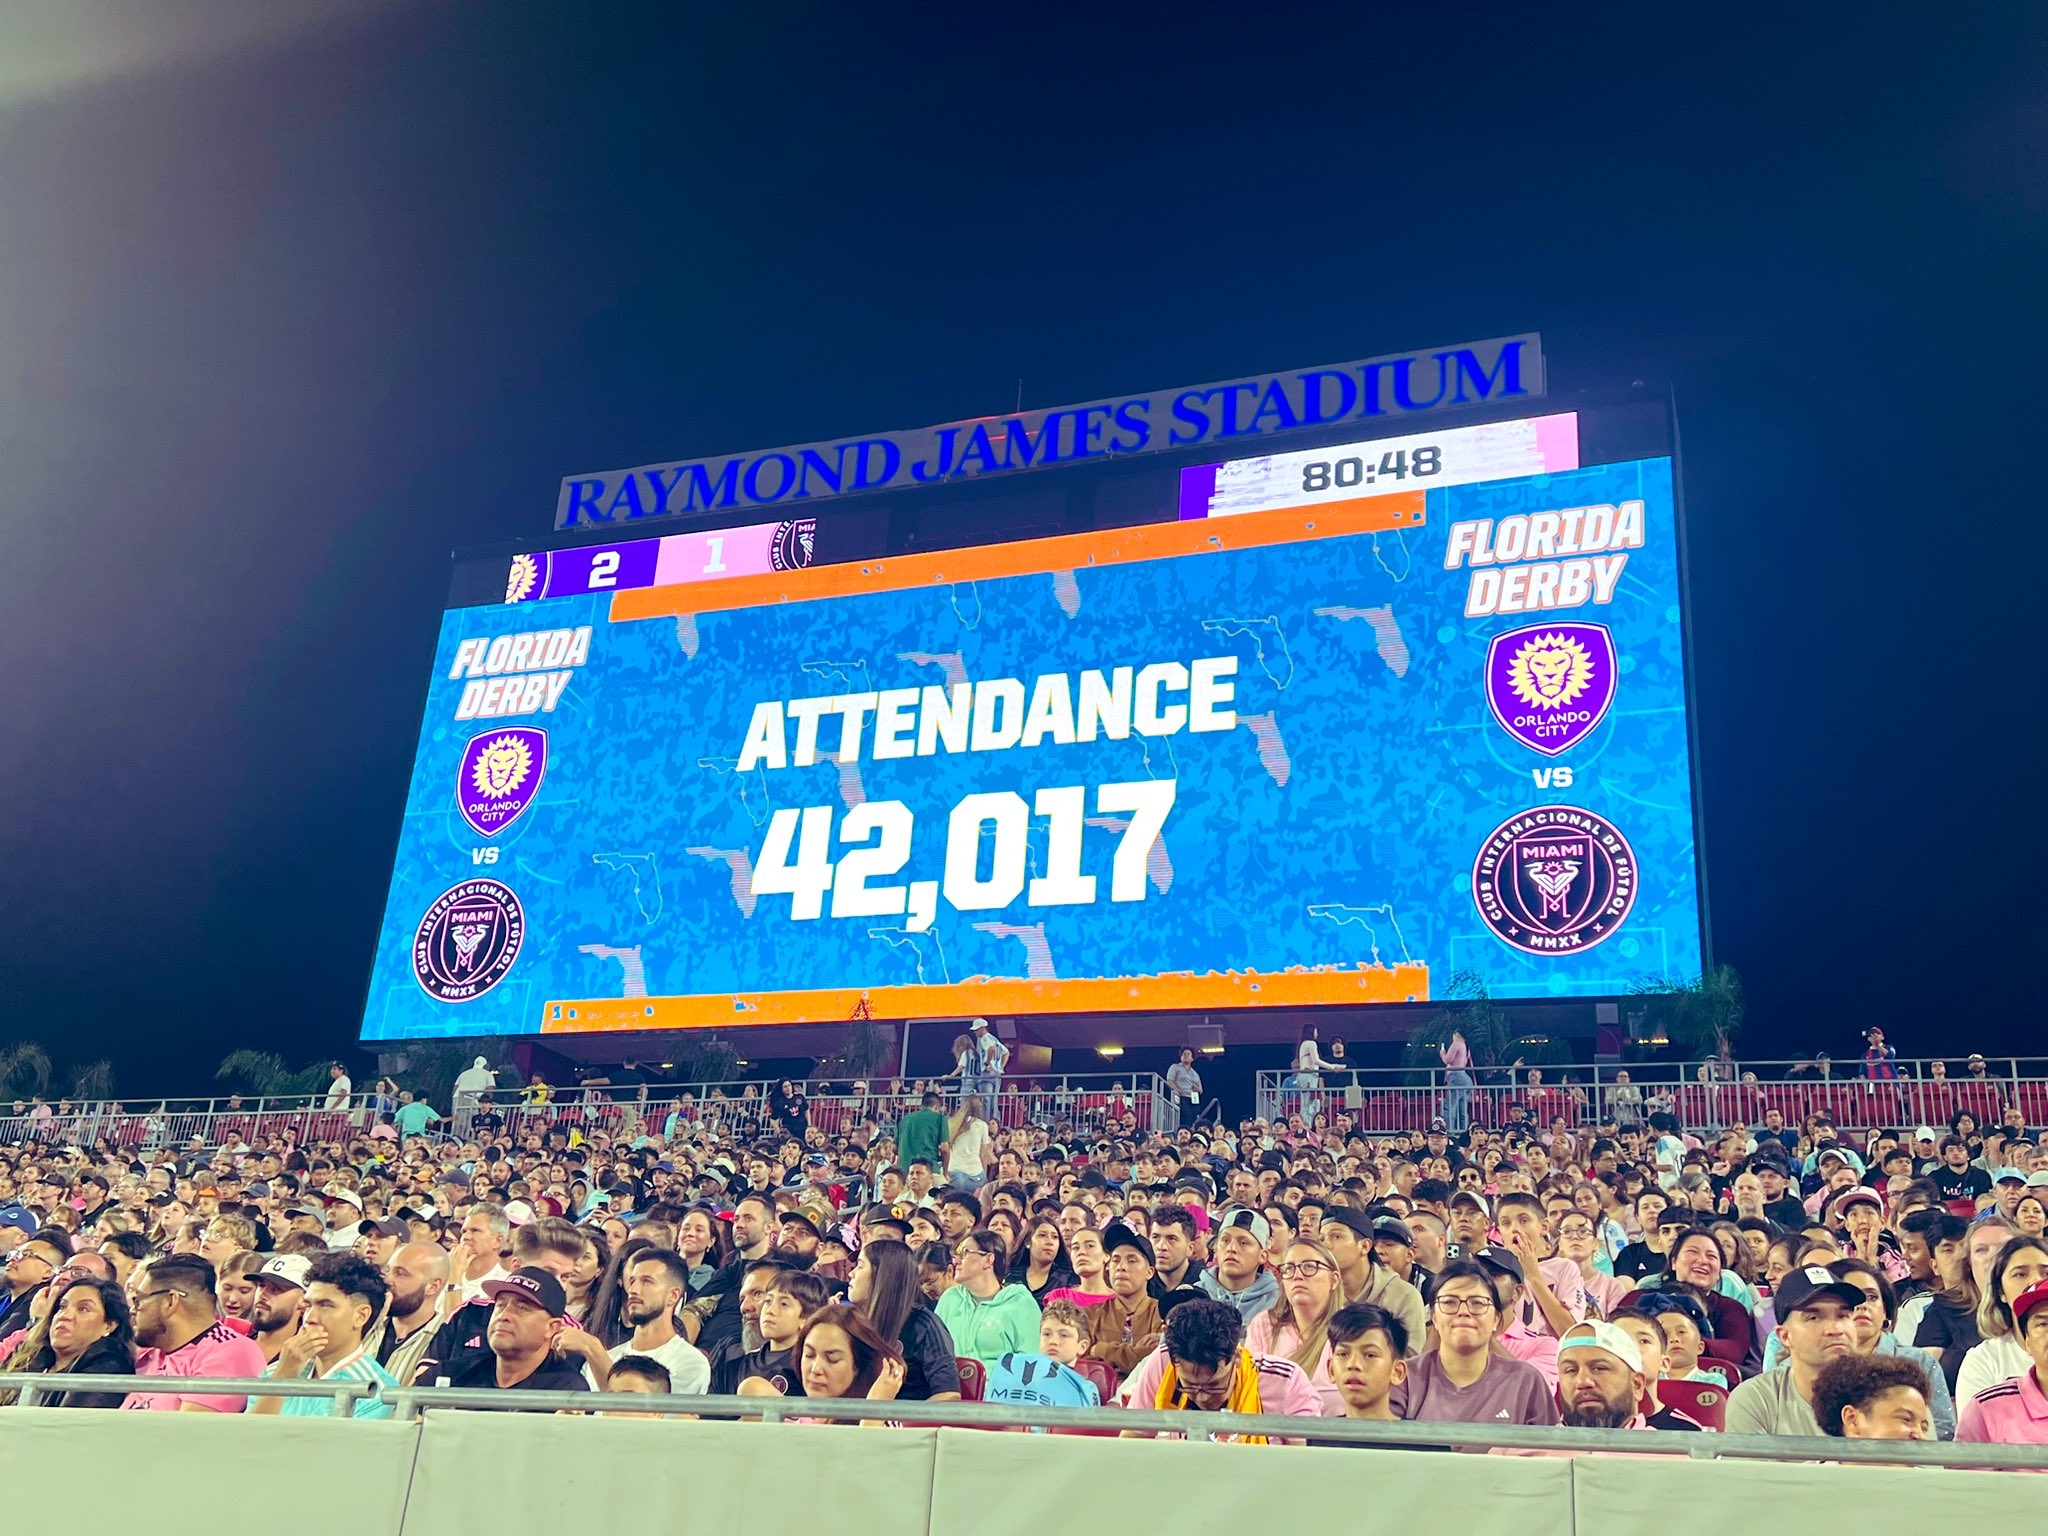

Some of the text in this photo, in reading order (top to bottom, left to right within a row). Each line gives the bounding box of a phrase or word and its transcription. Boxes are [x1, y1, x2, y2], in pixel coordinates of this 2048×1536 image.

[560, 341, 1528, 528] RAYMOND JAMES STADIUM
[1303, 445, 1442, 492] 80:48
[772, 519, 793, 569] CLUB INTE
[1444, 500, 1644, 569] FLORIDA
[587, 551, 621, 589] 2
[702, 537, 727, 573] 1
[1464, 553, 1629, 618] DERBY
[448, 626, 592, 679] FLORIDA
[454, 670, 573, 721] DERBY
[736, 656, 1239, 772] ATTENDANCE
[1514, 710, 1591, 727] ORLANDO
[1535, 723, 1570, 738] CITY
[1532, 766, 1573, 789] VS
[468, 800, 521, 814] ORLANDO
[481, 811, 506, 823] CITY
[472, 846, 500, 865] VS
[750, 778, 1177, 932] 42,017
[1481, 812, 1600, 875] INTERNACIONAL
[1523, 844, 1584, 859] MIAMI
[1602, 835, 1622, 854] DE
[421, 884, 508, 936] INTERNACIONAL
[451, 910, 494, 923] MIAMI
[506, 902, 518, 919] DE
[1480, 881, 1503, 921] CLUB
[417, 941, 429, 974] CLUB
[1530, 933, 1582, 948] MMXX
[441, 985, 476, 997] MMXX
[1701, 1394, 1712, 1404] 11
